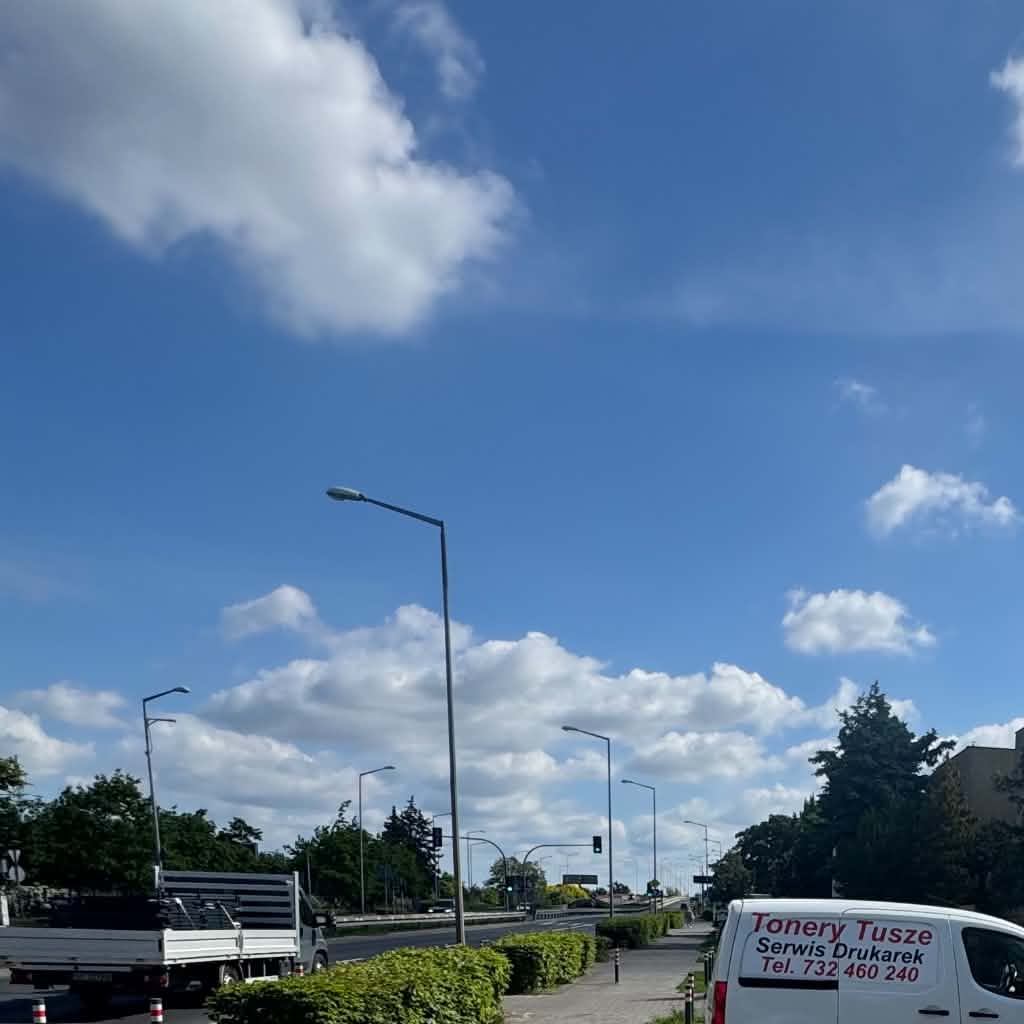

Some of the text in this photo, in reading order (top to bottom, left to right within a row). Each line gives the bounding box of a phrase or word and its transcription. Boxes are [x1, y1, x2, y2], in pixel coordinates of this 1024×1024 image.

[752, 912, 933, 945] Tonery Tusze
[756, 937, 925, 965] Serwis Drukarek
[761, 956, 919, 982] Tel. 732 460 240
